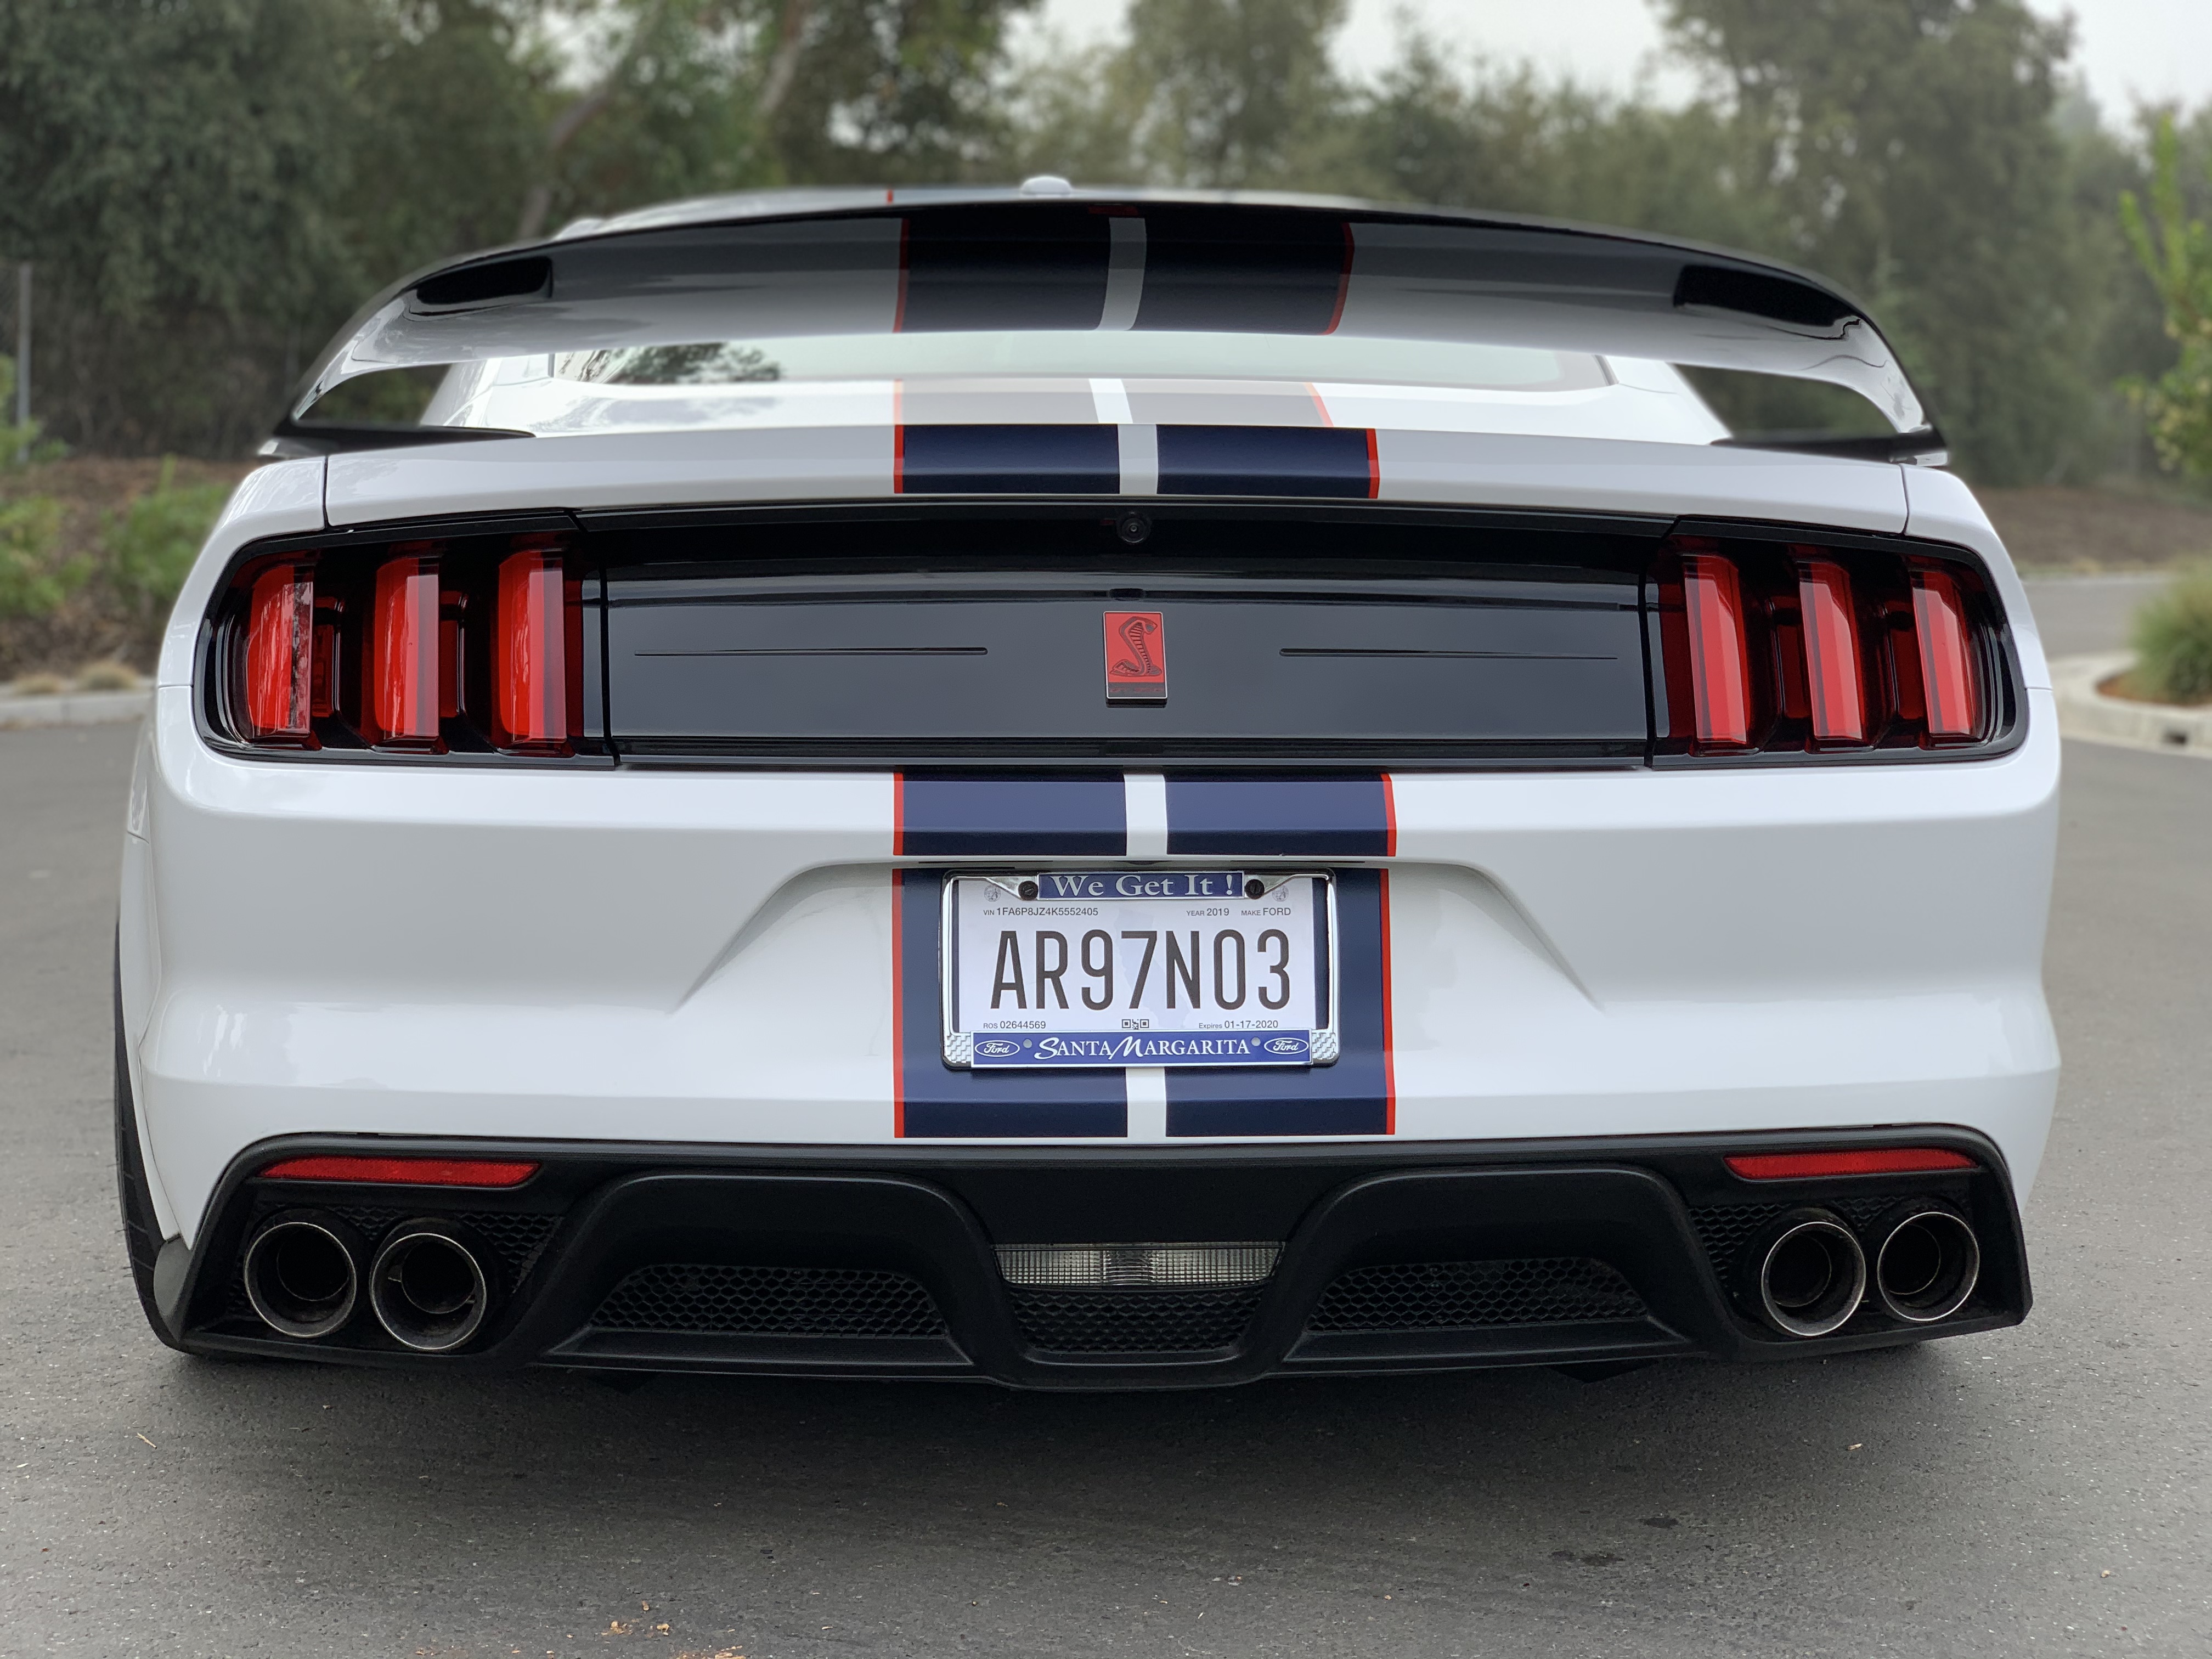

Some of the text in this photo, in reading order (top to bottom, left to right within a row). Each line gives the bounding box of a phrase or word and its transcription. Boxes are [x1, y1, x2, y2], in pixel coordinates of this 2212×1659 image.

[1050, 875, 1104, 896] We
[1115, 874, 1173, 896] Get
[1184, 874, 1213, 895] It
[997, 907, 1098, 916] 1FA6P8JZ4K5552405
[1263, 907, 1291, 916] FORD
[990, 929, 1290, 1010] AR97N03
[1000, 1020, 1046, 1029] 02644569
[1224, 1020, 1278, 1029] 01-17-2020
[983, 1043, 1009, 1054] Ford
[1034, 1036, 1251, 1060] SANTA MARGARITA
[1273, 1040, 1299, 1051] Ford
